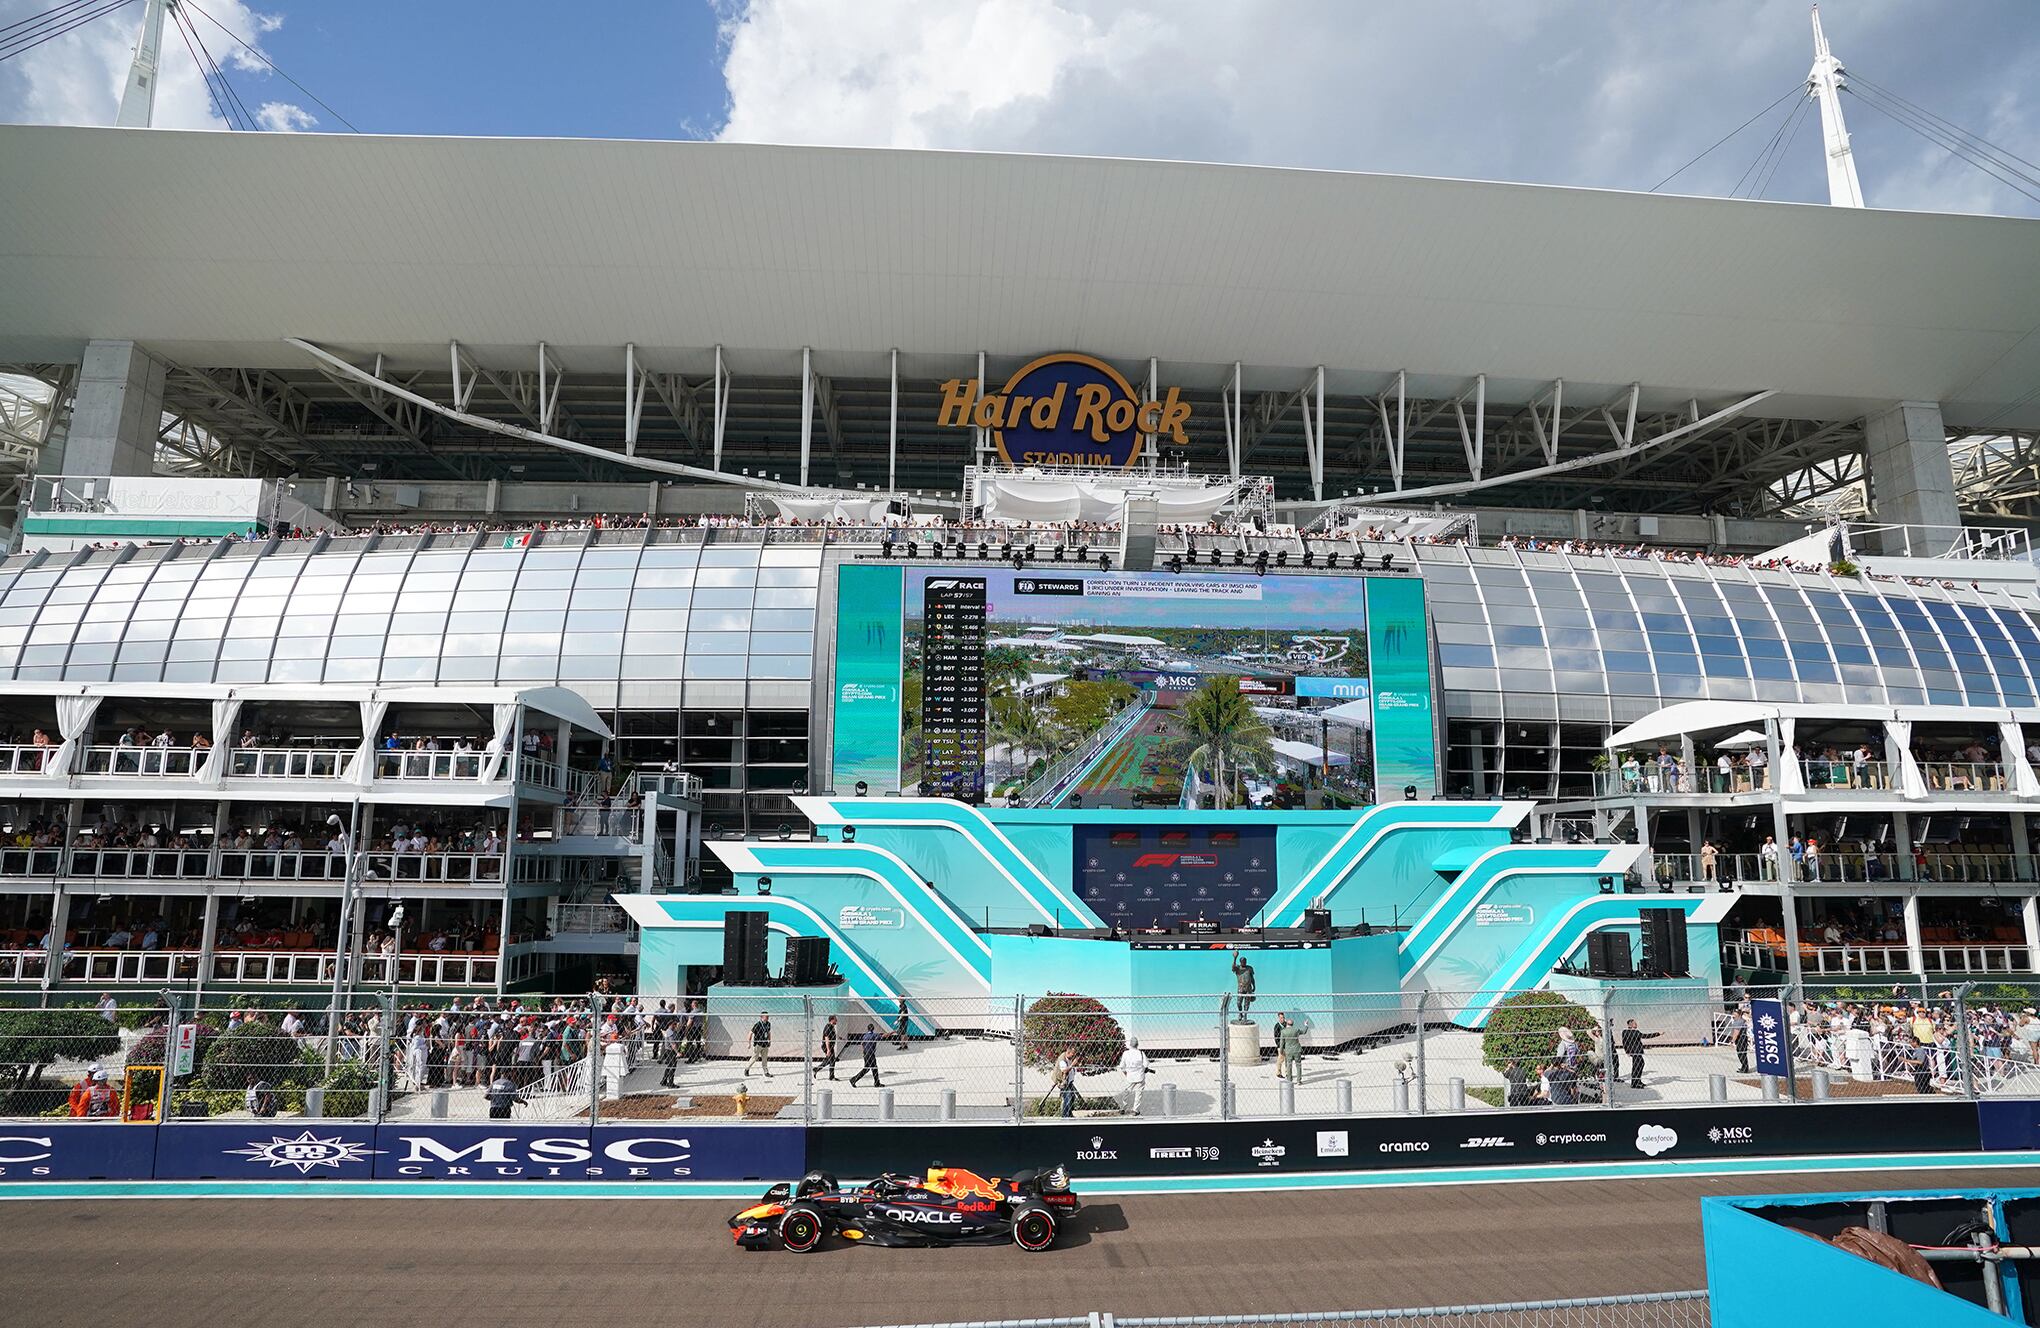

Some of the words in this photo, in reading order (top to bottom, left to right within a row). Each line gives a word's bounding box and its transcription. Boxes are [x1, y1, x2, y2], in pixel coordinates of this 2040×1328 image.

[937, 378, 1068, 430] Hard
[1073, 383, 1193, 445] Rock
[1169, 677, 1197, 686] MSC
[1764, 1031, 1779, 1065] MSC
[1641, 1133, 1673, 1143] salesforce
[1723, 1127, 1752, 1138] MSC
[1467, 1137, 1506, 1148] DHL
[1549, 1133, 1607, 1145] crypto.com
[398, 1137, 691, 1163] MSC
[1150, 1147, 1192, 1159] PIRELLI
[1379, 1142, 1430, 1153] aramco
[1076, 1151, 1118, 1160] ROLEX
[398, 1166, 691, 1176] CRUISES
[957, 1201, 977, 1211] Red
[978, 1201, 996, 1212] Bull
[886, 1209, 963, 1224] ORACLE
